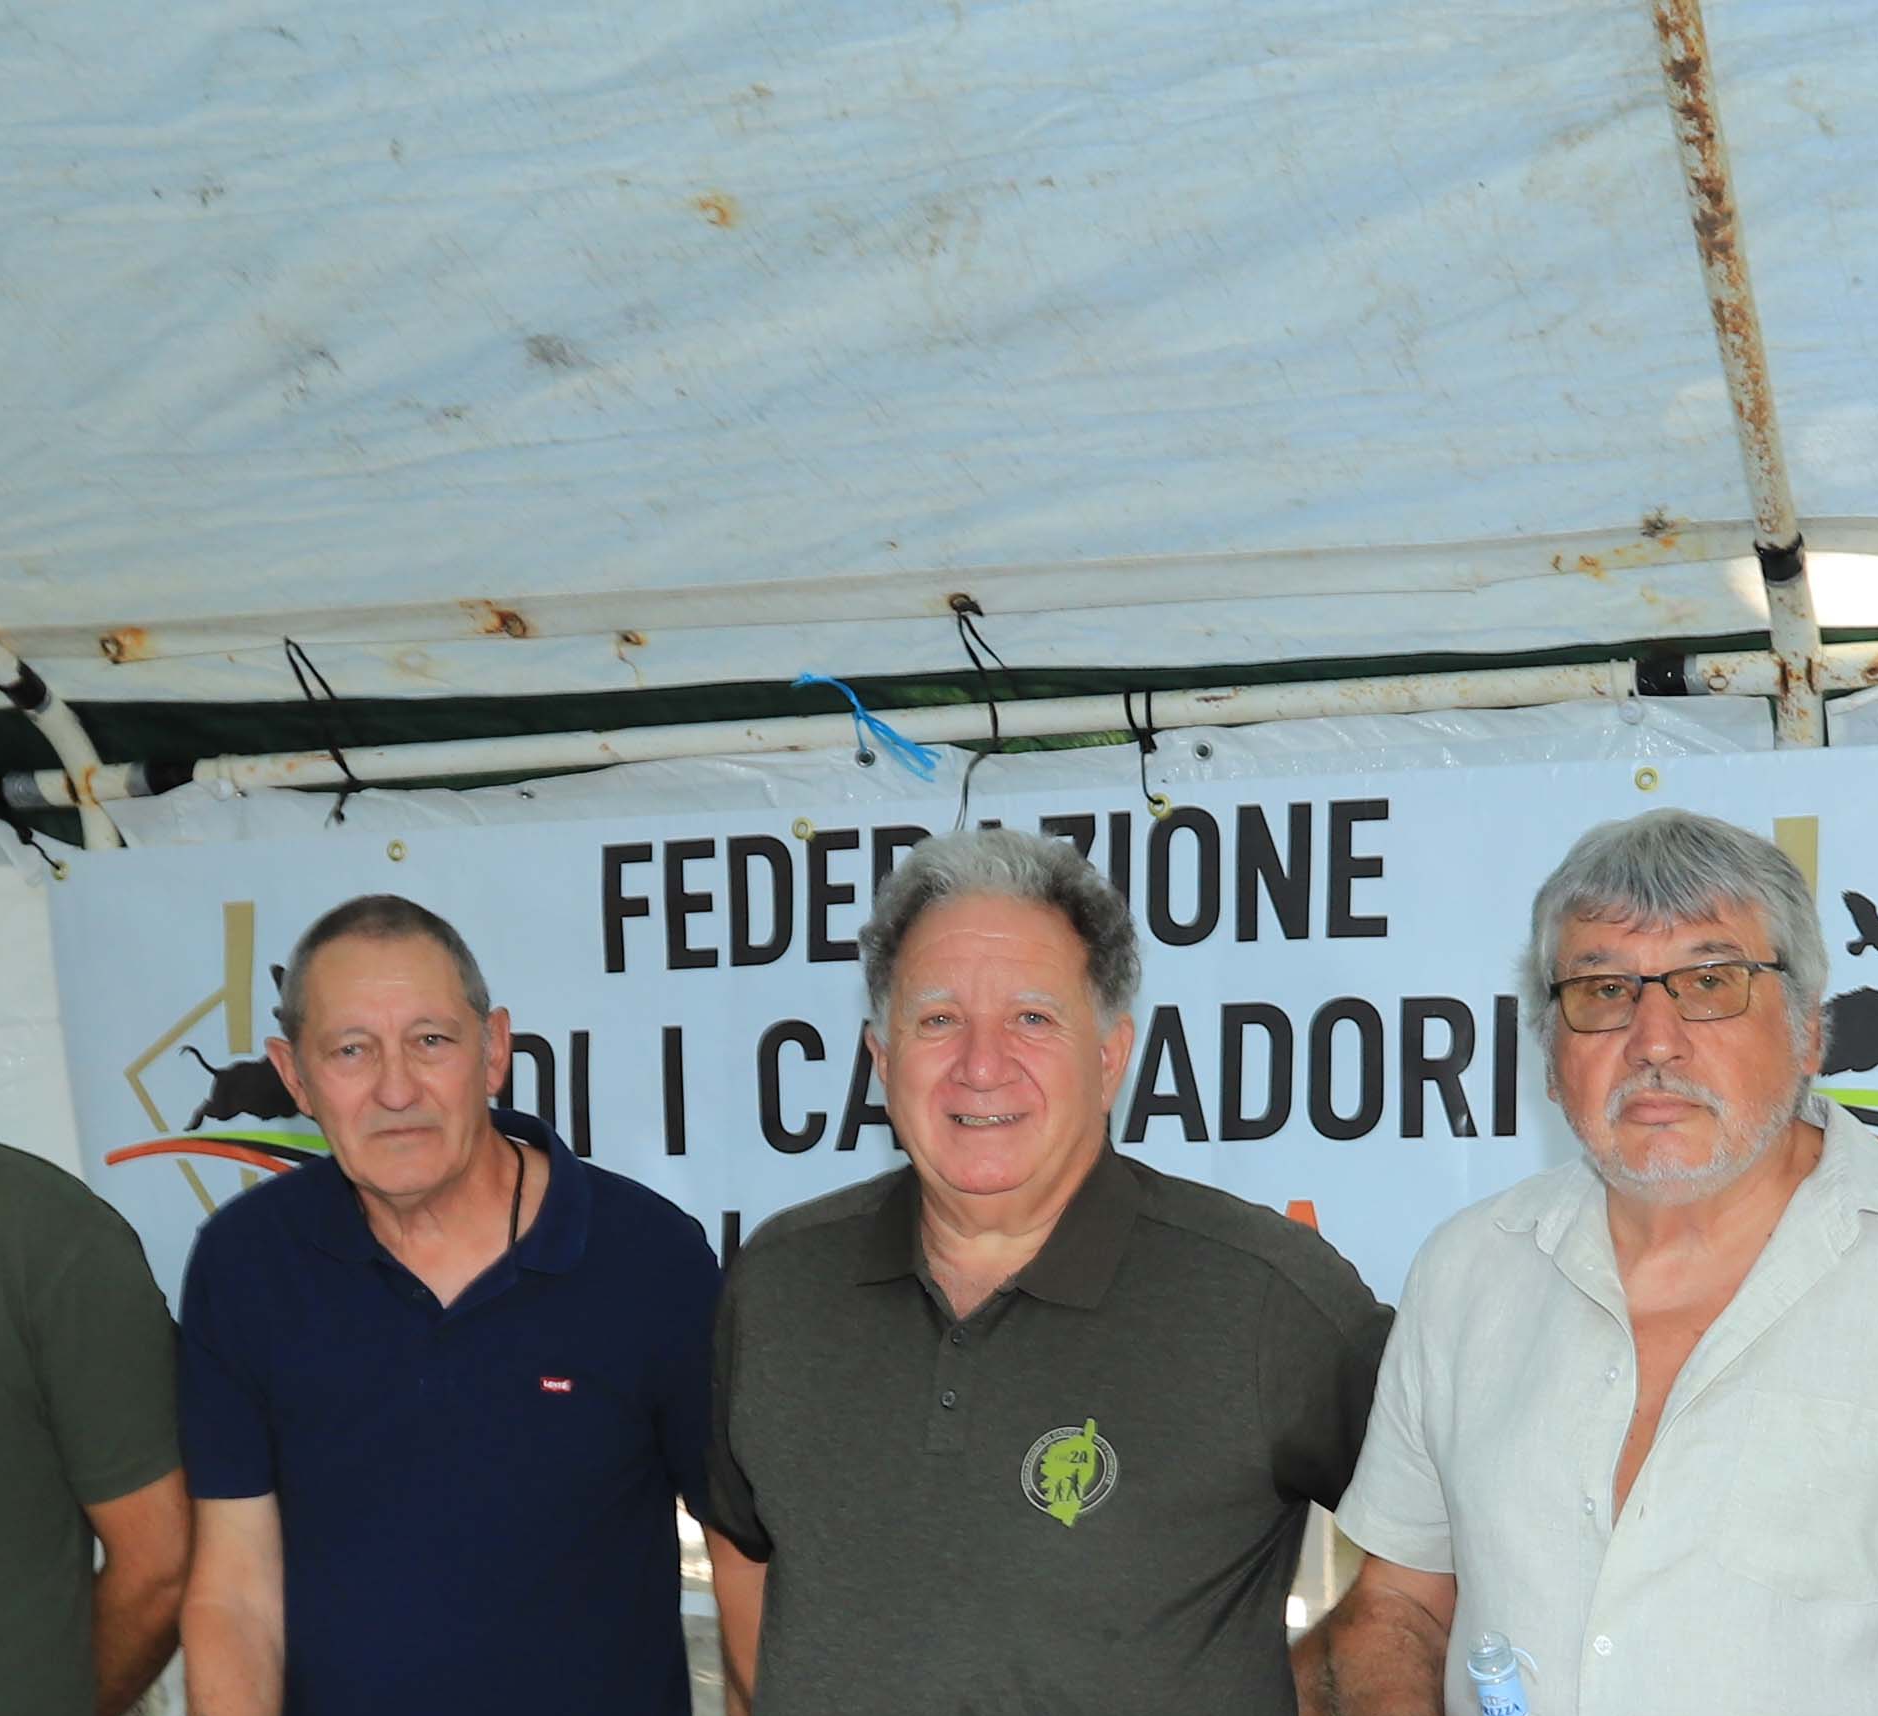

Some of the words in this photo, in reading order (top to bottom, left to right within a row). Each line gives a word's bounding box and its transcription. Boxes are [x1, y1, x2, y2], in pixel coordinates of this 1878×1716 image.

[601, 798, 1389, 973] FEDEIONE
[661, 1025, 687, 1156] I
[756, 993, 1520, 1155] CAADORI
